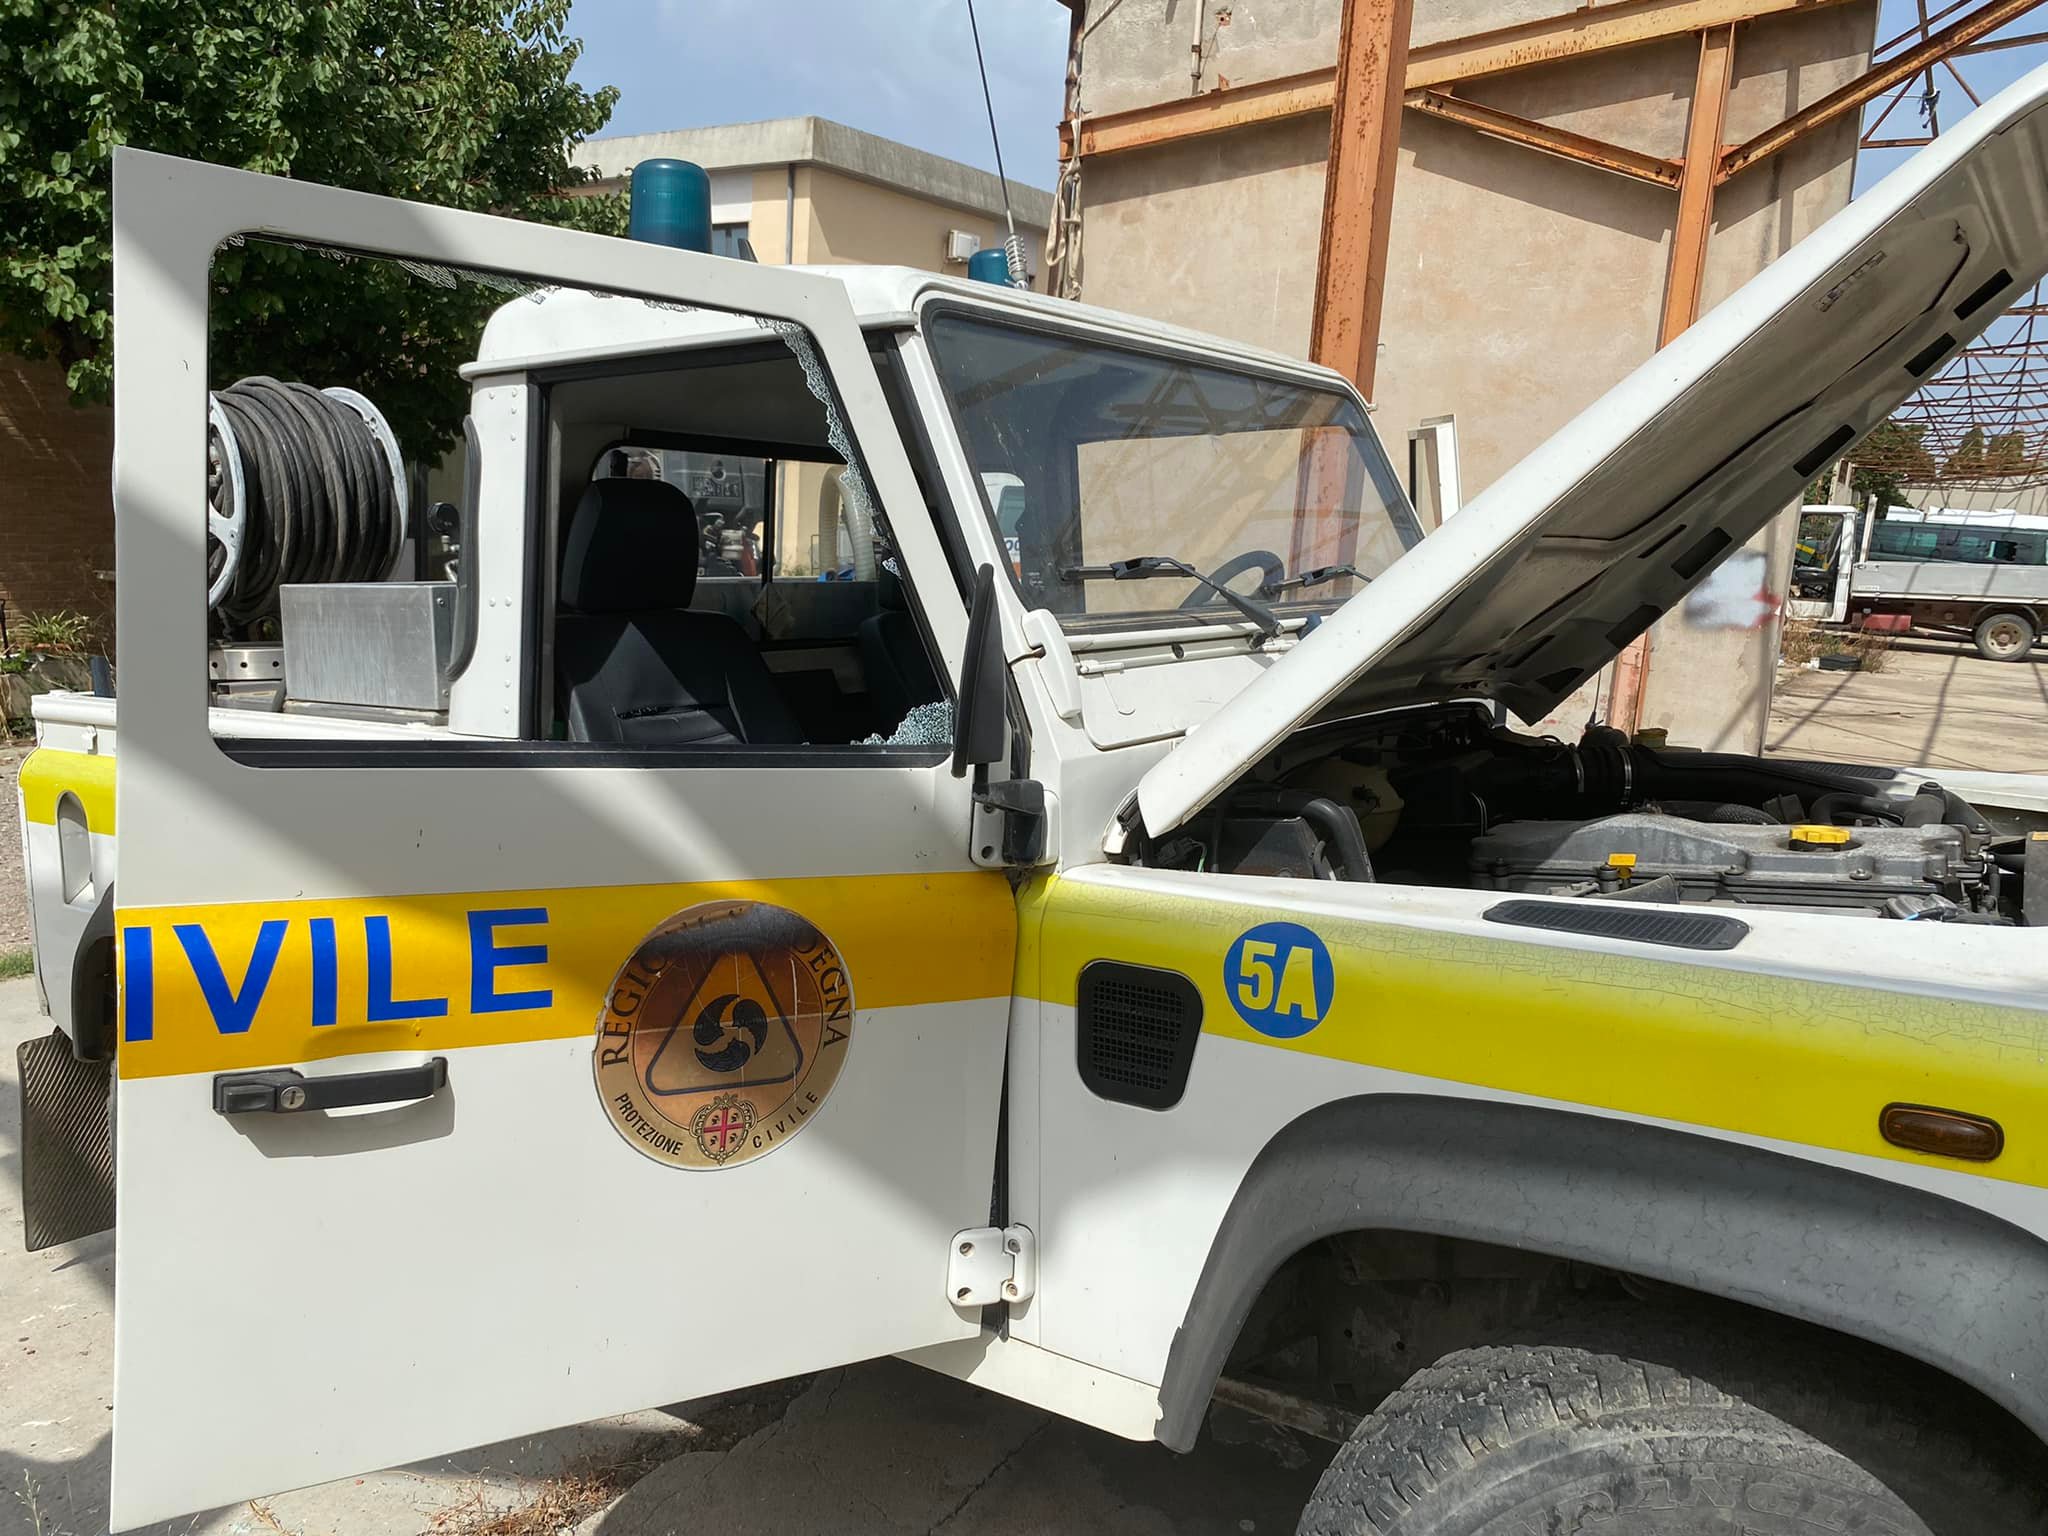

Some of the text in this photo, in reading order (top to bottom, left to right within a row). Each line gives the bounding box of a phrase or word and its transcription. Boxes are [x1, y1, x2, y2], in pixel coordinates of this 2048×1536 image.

[123, 907, 553, 1043] IVILE
[1237, 938, 1319, 1021] 5A
[614, 1090, 818, 1156] PROTEZIONE CIVILE
